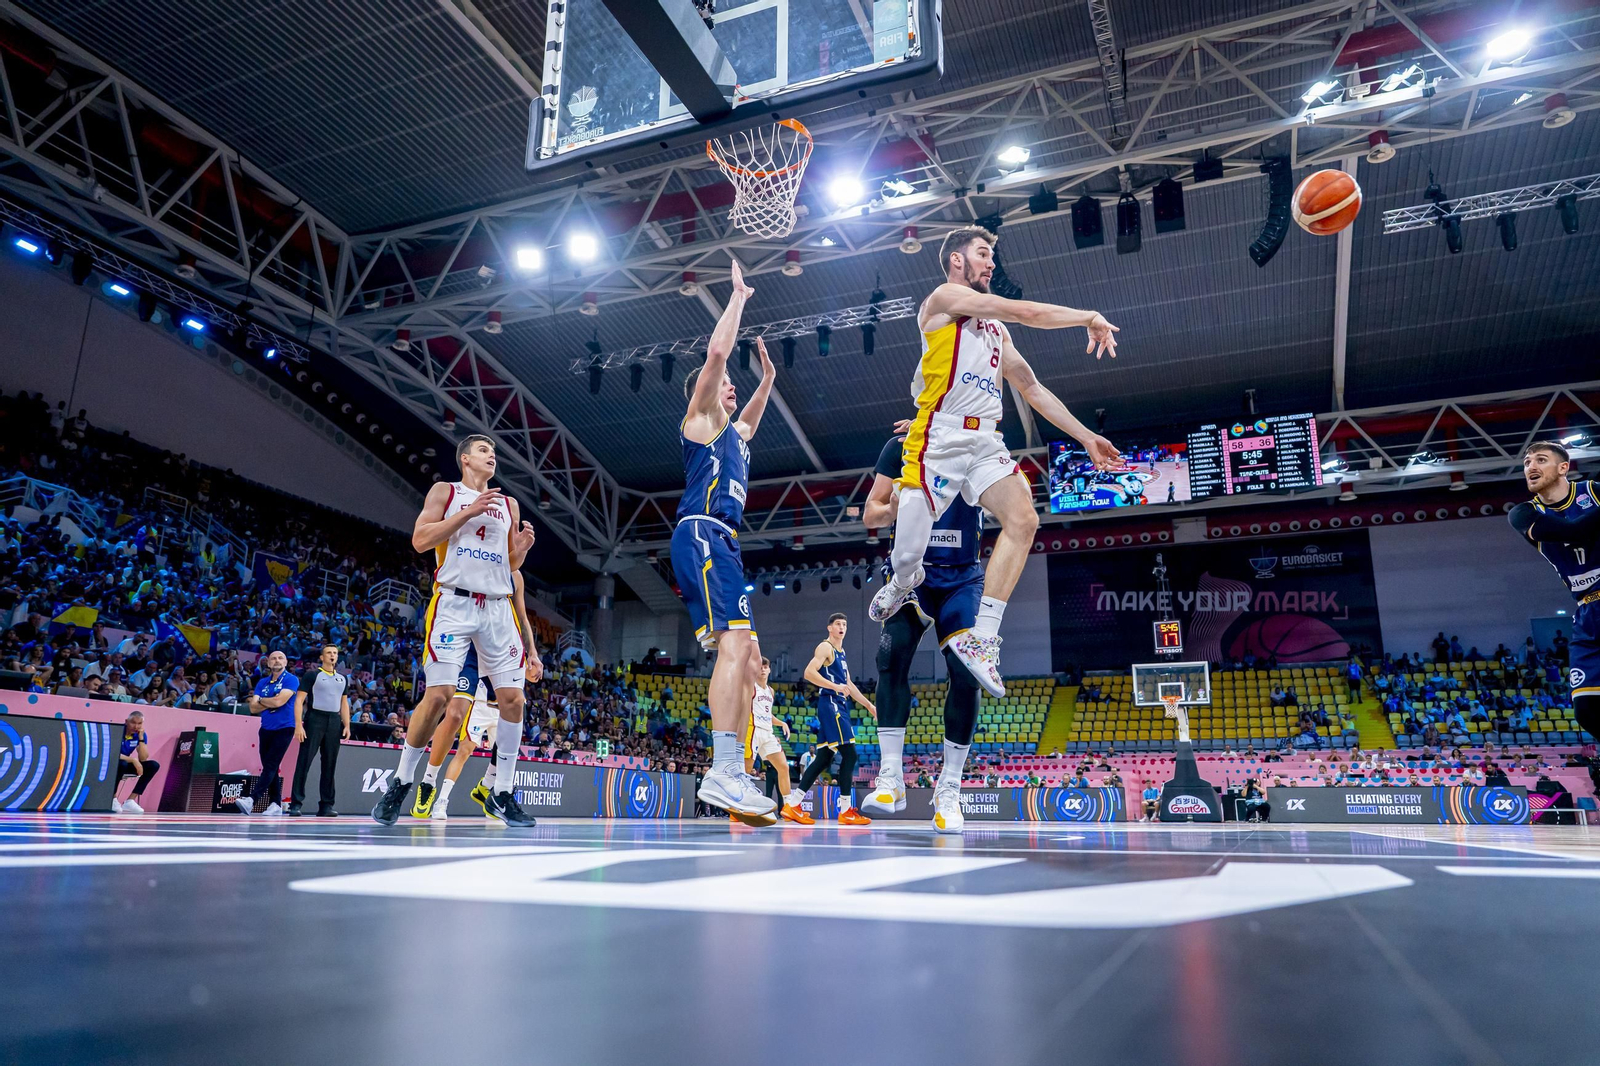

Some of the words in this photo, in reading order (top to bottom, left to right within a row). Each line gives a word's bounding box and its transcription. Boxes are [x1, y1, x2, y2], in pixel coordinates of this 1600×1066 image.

[990, 347, 1000, 368] 8
[1232, 441, 1243, 449] 58
[1242, 450, 1262, 459] 5:45
[1059, 500, 1090, 509] FANSHOP
[1092, 498, 1110, 506] NOW!
[476, 525, 486, 541] 4
[930, 534, 957, 542] mach
[456, 546, 502, 564] endesa
[1282, 552, 1343, 566] EUROBASKET
[1097, 591, 1172, 611] MAKE
[1178, 591, 1250, 612] YOUR
[1254, 591, 1340, 612] MARK
[1160, 623, 1178, 632] 5:45
[1164, 633, 1178, 646] 17
[362, 768, 394, 792] 1X
[540, 772, 564, 788] EVERY
[221, 784, 243, 792] MAKE
[523, 790, 562, 806] TOGETHER
[975, 794, 999, 802] EVERY
[1346, 794, 1392, 804] ELEVATING
[1394, 794, 1422, 804] EVERY
[961, 804, 999, 814] TOGETHER
[1287, 799, 1306, 810] 1X
[1378, 806, 1422, 815] TOGETHER
